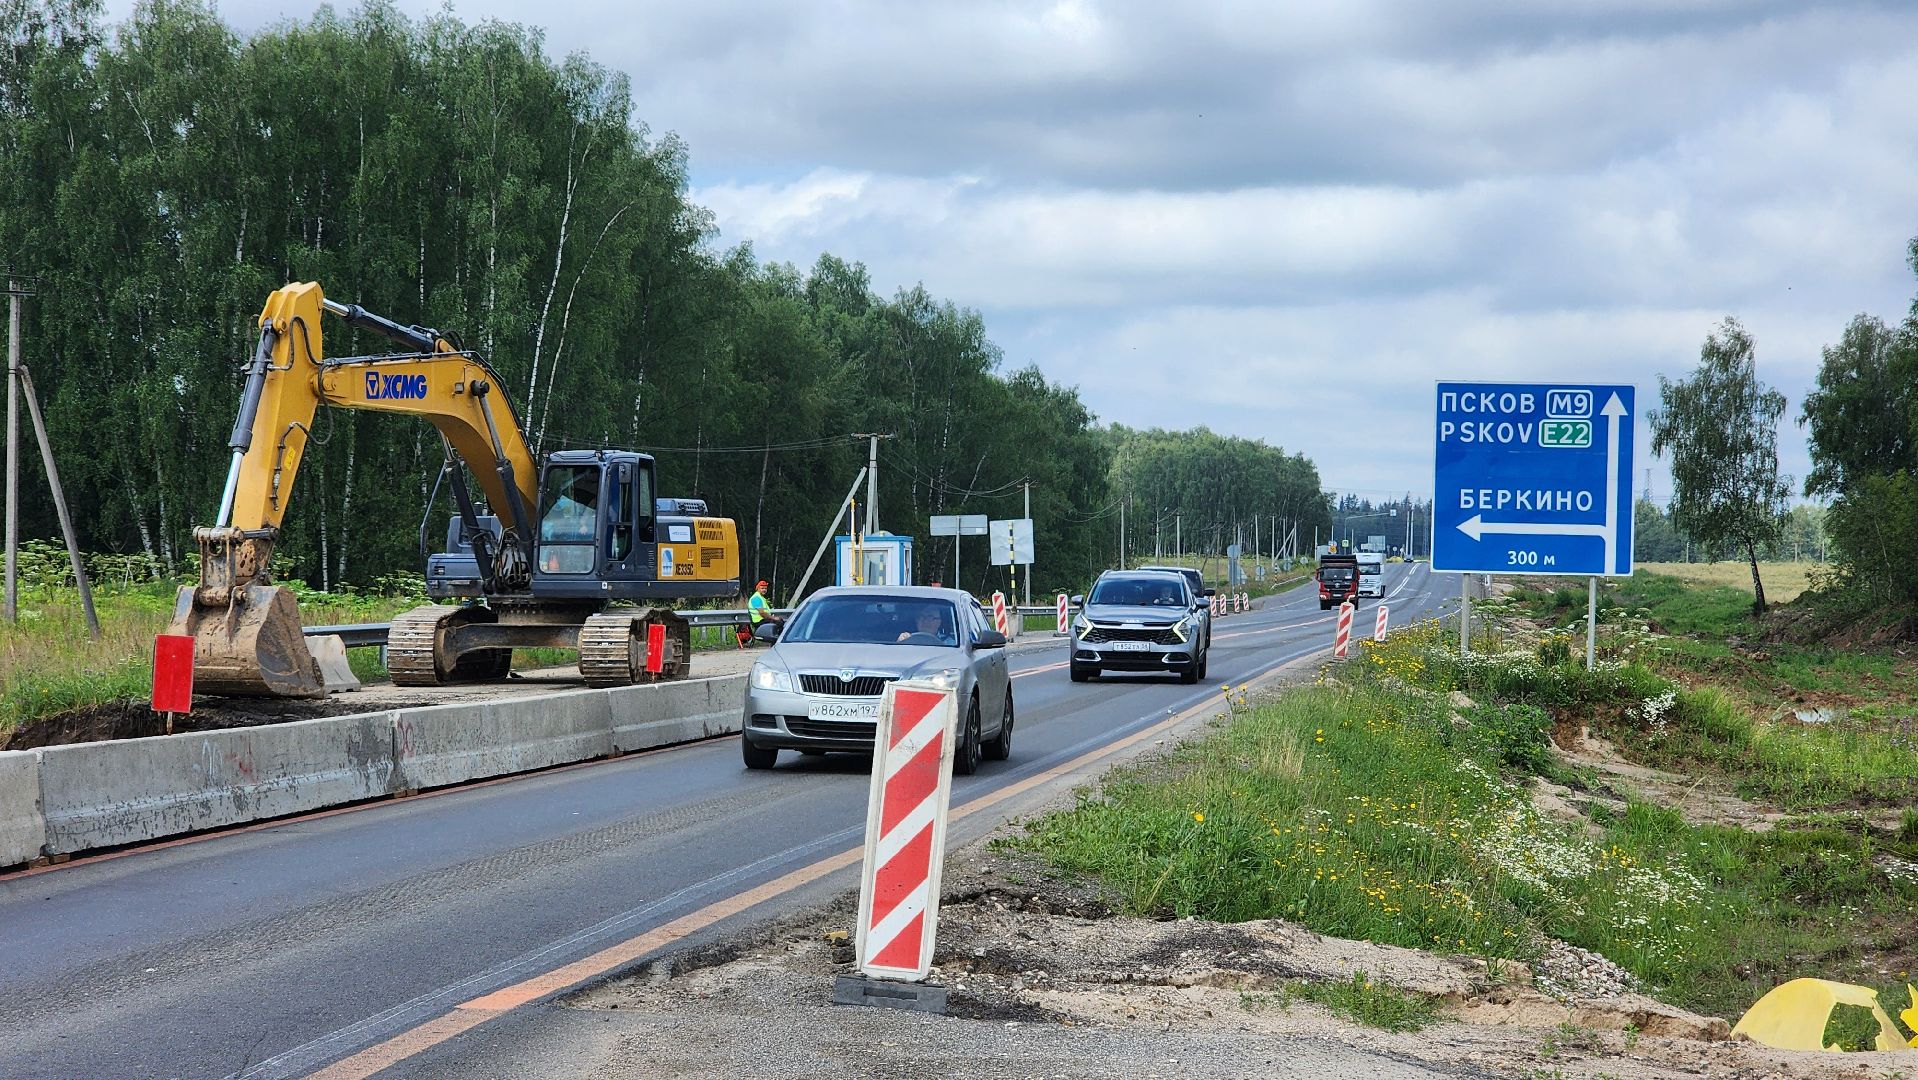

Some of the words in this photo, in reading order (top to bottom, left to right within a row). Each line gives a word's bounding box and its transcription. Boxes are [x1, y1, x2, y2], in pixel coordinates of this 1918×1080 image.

[381, 374, 428, 400] XCMG
[1441, 392, 1536, 414] ПСКОВ
[1551, 393, 1588, 414] М9
[1440, 421, 1533, 443] PSKOV
[1543, 423, 1589, 444] E22
[1460, 488, 1593, 511] БЕРКИНО
[1507, 550, 1538, 565] 300
